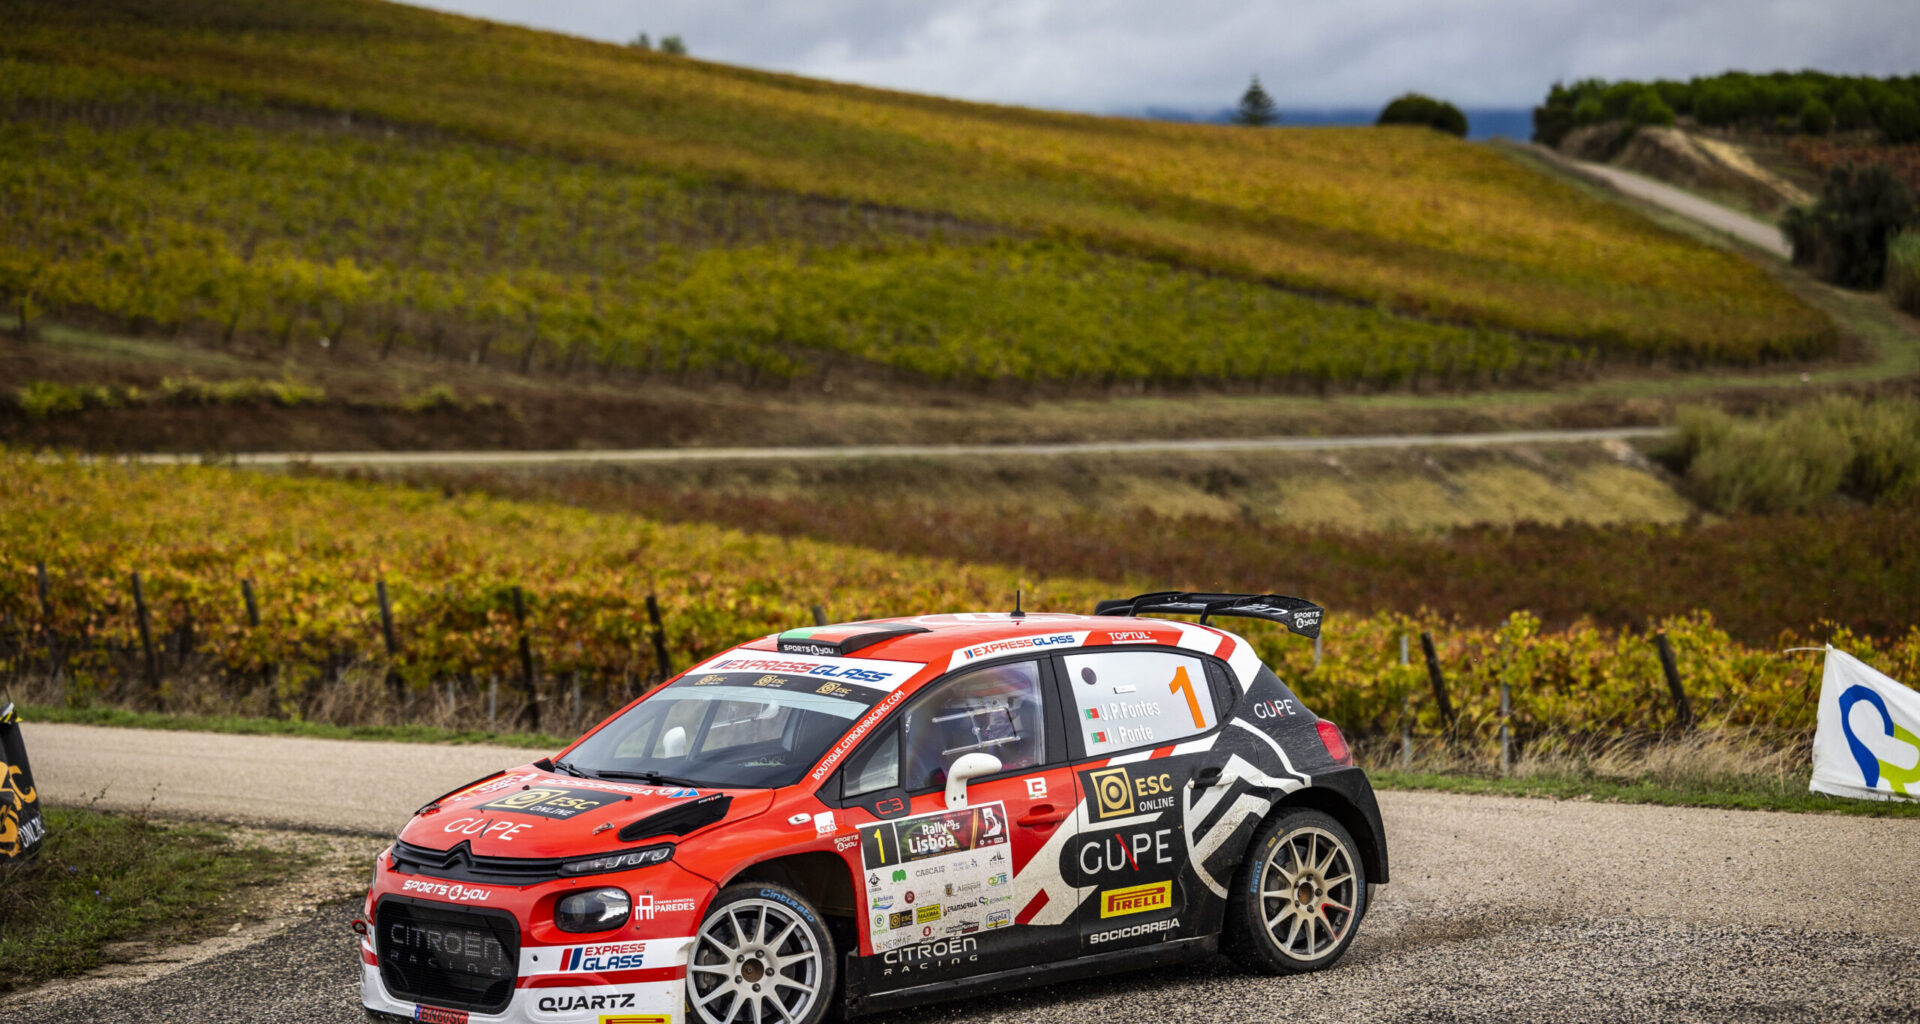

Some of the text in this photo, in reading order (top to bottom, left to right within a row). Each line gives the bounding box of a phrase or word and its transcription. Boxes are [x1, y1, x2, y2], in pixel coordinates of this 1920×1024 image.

[1293, 611, 1320, 619] SPORTS
[1107, 631, 1148, 641] TOPTUL
[1168, 666, 1206, 728] 1
[1118, 724, 1154, 743] Ponte
[1136, 773, 1173, 797] ESC
[529, 805, 575, 816] ONLINE
[546, 796, 600, 810] ESC
[876, 797, 904, 815] C3
[1139, 797, 1175, 812] ONLINE
[921, 822, 948, 836] Rally
[873, 828, 885, 864] 1
[908, 834, 955, 854] Lisboa
[915, 866, 945, 877] CASCAIS
[655, 902, 695, 912] PAREDES
[760, 888, 815, 923] Cinturato
[1107, 886, 1166, 912] PIRELLI
[1089, 917, 1180, 945] SOCICORREIA
[584, 943, 646, 956] EXPRESS
[582, 954, 644, 971] GLASS
[883, 954, 978, 977] RACING
[538, 993, 635, 1012] QUARTZ
